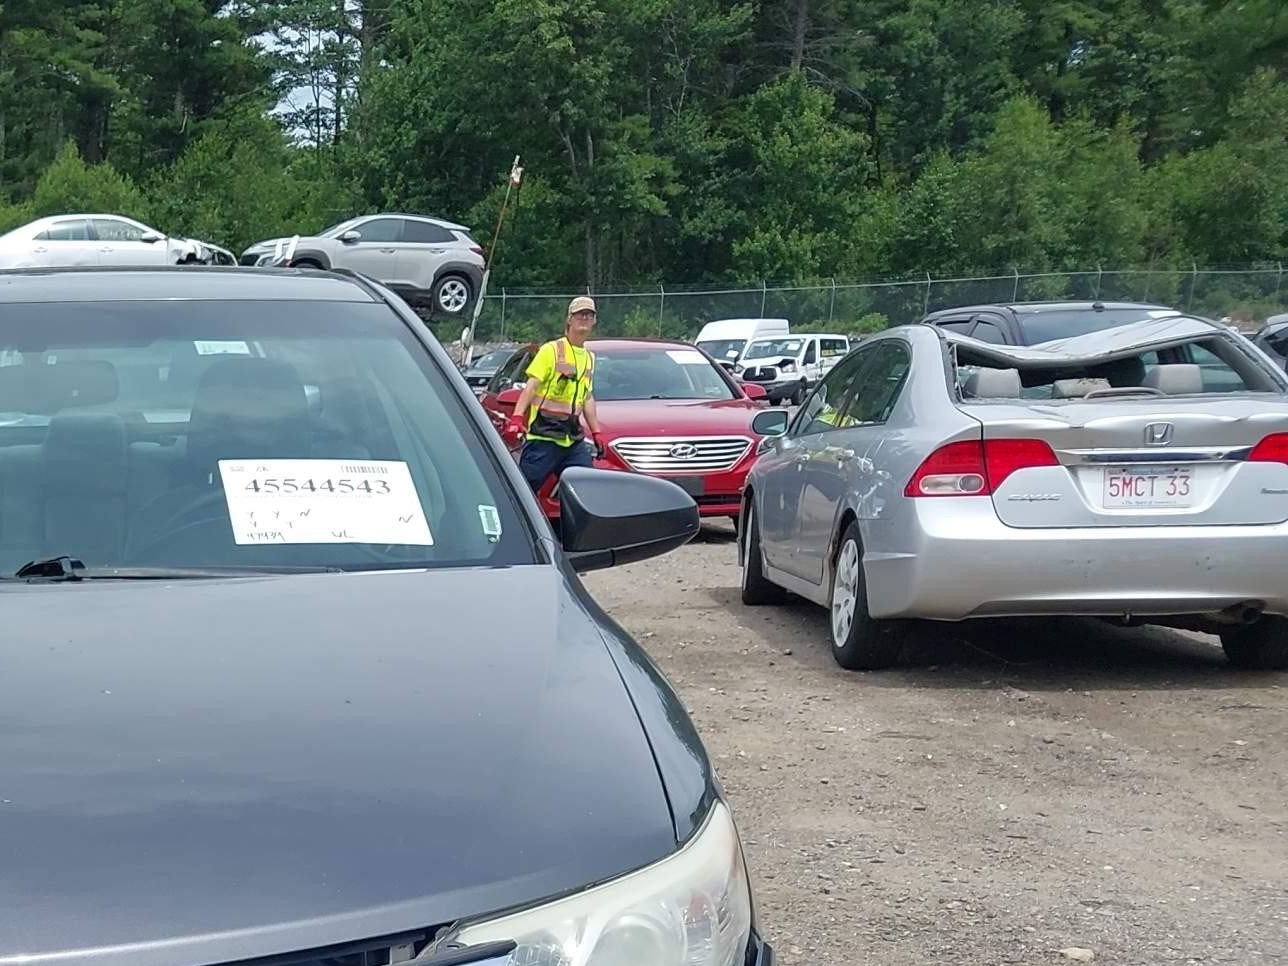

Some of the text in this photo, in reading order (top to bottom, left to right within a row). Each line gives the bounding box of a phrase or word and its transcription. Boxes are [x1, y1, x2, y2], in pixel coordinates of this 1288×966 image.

[244, 479, 391, 494] 45544543
[1109, 475, 1190, 497] 5MCT 33
